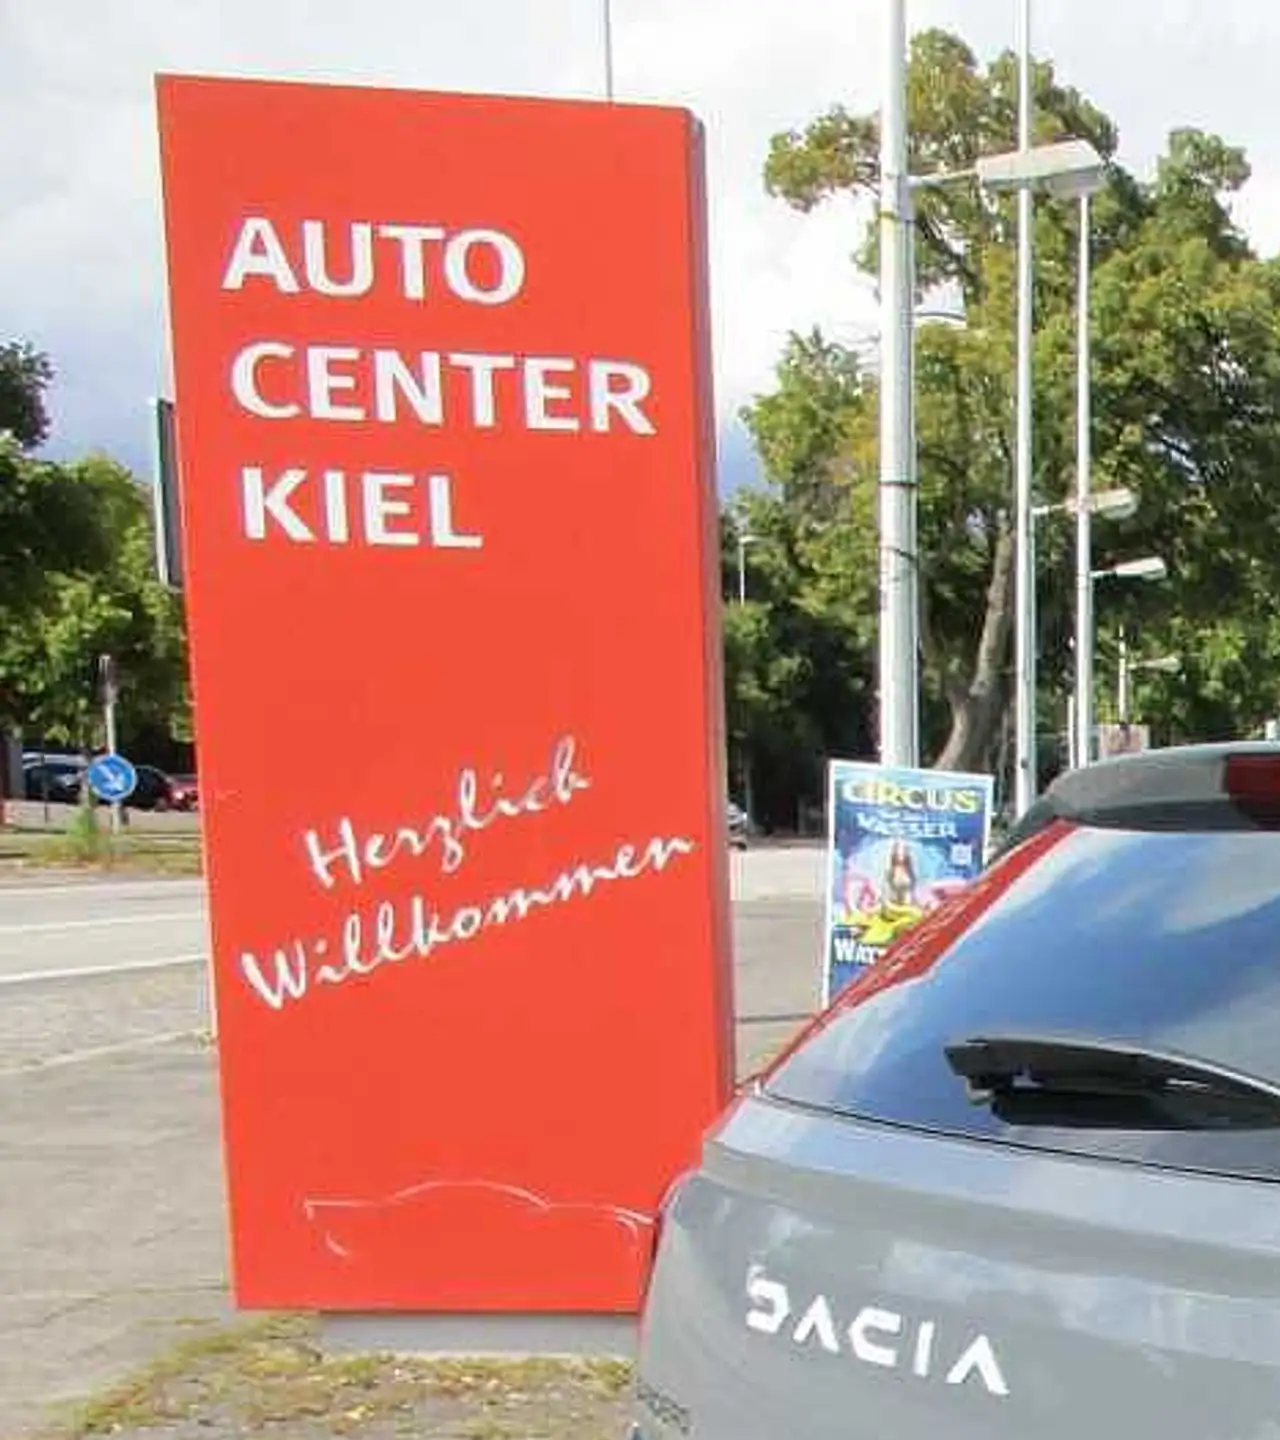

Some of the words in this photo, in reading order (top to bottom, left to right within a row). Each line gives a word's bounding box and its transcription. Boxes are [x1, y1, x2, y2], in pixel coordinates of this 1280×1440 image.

[222, 216, 525, 305] AUTO
[231, 341, 656, 435] CENTER
[242, 466, 483, 548] KIEL
[304, 736, 593, 873] Herzlich
[842, 779, 978, 812] CIRCUS
[241, 836, 696, 1009] Willkommen
[746, 1264, 1010, 1396] DACIA
